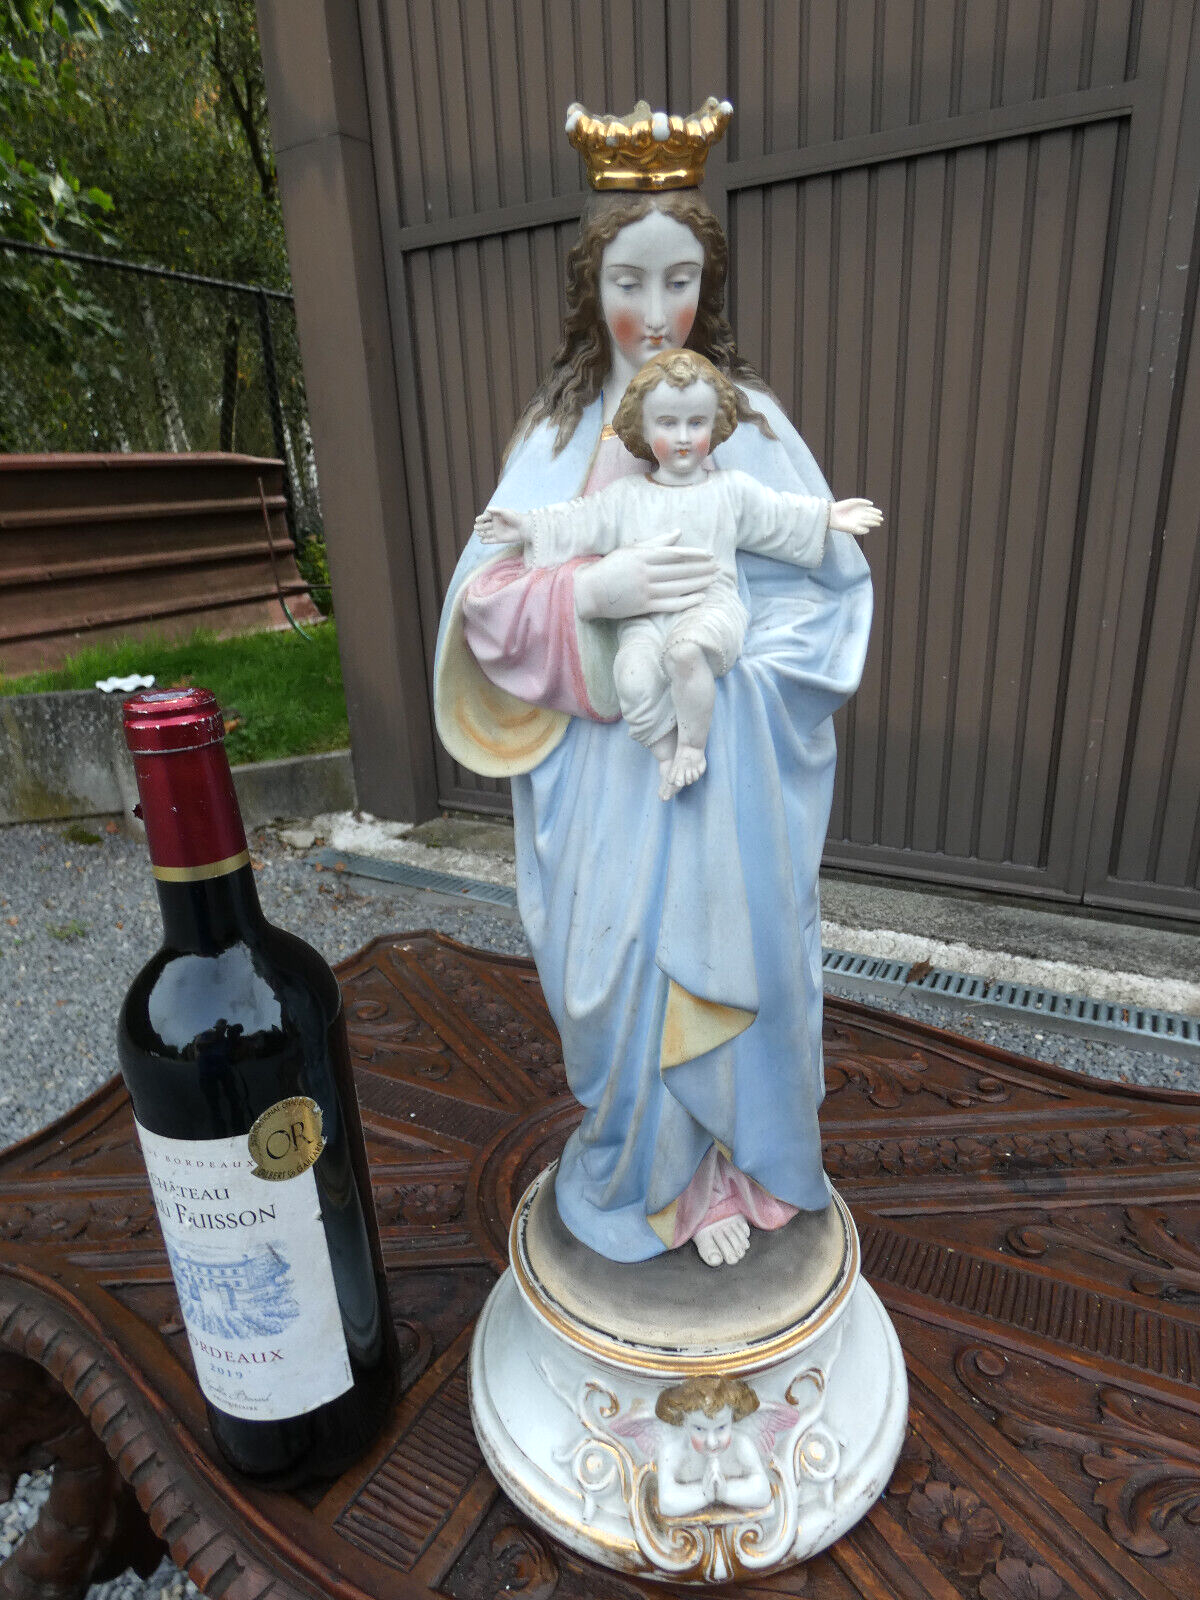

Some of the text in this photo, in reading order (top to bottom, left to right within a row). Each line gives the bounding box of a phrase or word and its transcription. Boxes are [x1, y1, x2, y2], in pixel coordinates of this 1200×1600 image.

[266, 1121, 313, 1160] OR
[165, 1155, 255, 1168] BORDEAUX
[189, 1332, 284, 1363] ORDEAUX
[210, 1362, 243, 1379] 2019
